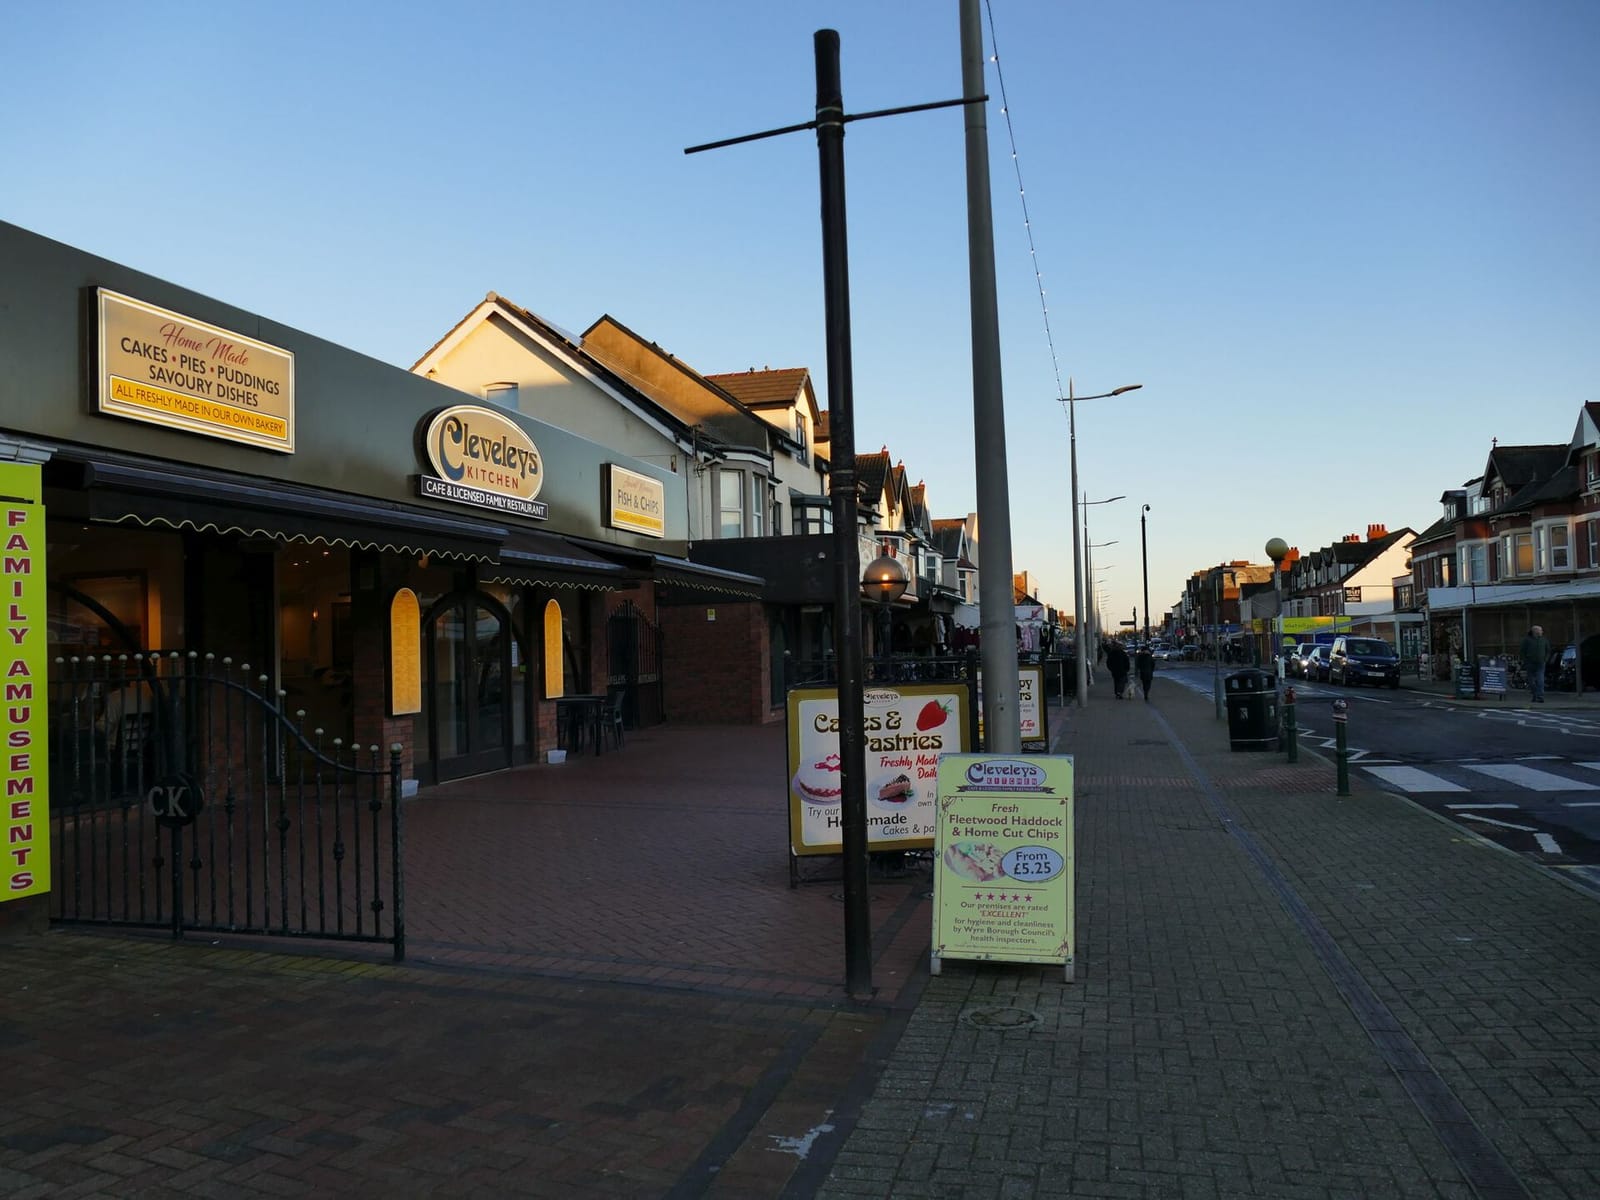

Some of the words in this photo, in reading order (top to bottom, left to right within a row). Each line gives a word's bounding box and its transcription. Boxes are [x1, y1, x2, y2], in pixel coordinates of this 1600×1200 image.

[160, 323, 203, 351] Home
[205, 337, 249, 366] Made
[120, 337, 168, 363] CAKES
[180, 354, 206, 374] PIES
[217, 365, 280, 395] PUDDINGS
[149, 365, 213, 395] SAVOURY
[217, 385, 258, 407] DISHES
[116, 384, 134, 398] ALL
[136, 388, 172, 407] FRESHLY
[174, 399, 200, 414] MADE
[201, 405, 211, 416] IN
[212, 408, 231, 421] OUR
[233, 413, 254, 427] OWN
[255, 418, 283, 433] BAKERY
[439, 416, 538, 481] Cleveleys
[467, 466, 519, 489] KITCHEN
[426, 481, 447, 494] CAFE
[447, 487, 453, 497] &
[453, 488, 485, 504] LICENSED
[486, 494, 506, 508] FAMILY
[507, 500, 545, 516] RESTAURANT
[617, 489, 633, 507] FISH
[634, 495, 639, 508] &
[4, 509, 31, 645] FAMILY
[814, 713, 881, 733] Cas
[885, 711, 902, 731] &
[879, 755, 913, 770] Freshly
[6, 659, 35, 890] AMUSEMENTS
[968, 763, 1037, 783] Cleveleys
[148, 786, 187, 817] CK
[927, 791, 934, 799] In
[917, 800, 932, 808] own
[991, 803, 1019, 813] Fresh
[808, 806, 822, 819] Try
[825, 807, 839, 816] our
[949, 814, 1008, 825] Fleetwood
[1011, 815, 1063, 826] Haddock
[827, 813, 907, 828] Hemade
[882, 825, 909, 836] Cakes
[912, 824, 920, 833] &
[952, 827, 961, 837] &
[965, 827, 999, 837] Home
[1002, 828, 1023, 838] Cut
[1027, 829, 1060, 841] Chips
[1016, 851, 1048, 861] From
[1014, 861, 1052, 875] £5.25
[960, 901, 975, 909] Our
[977, 902, 1011, 911] premises
[1027, 903, 1049, 911] rated
[953, 925, 962, 934] by
[964, 926, 985, 935] Wyre
[987, 926, 1019, 936] Borough
[967, 918, 996, 927] hygiene
[998, 919, 1012, 927] and
[1013, 920, 1054, 928] cleanliness
[970, 934, 994, 942] health
[996, 935, 1037, 944] inspectors.
